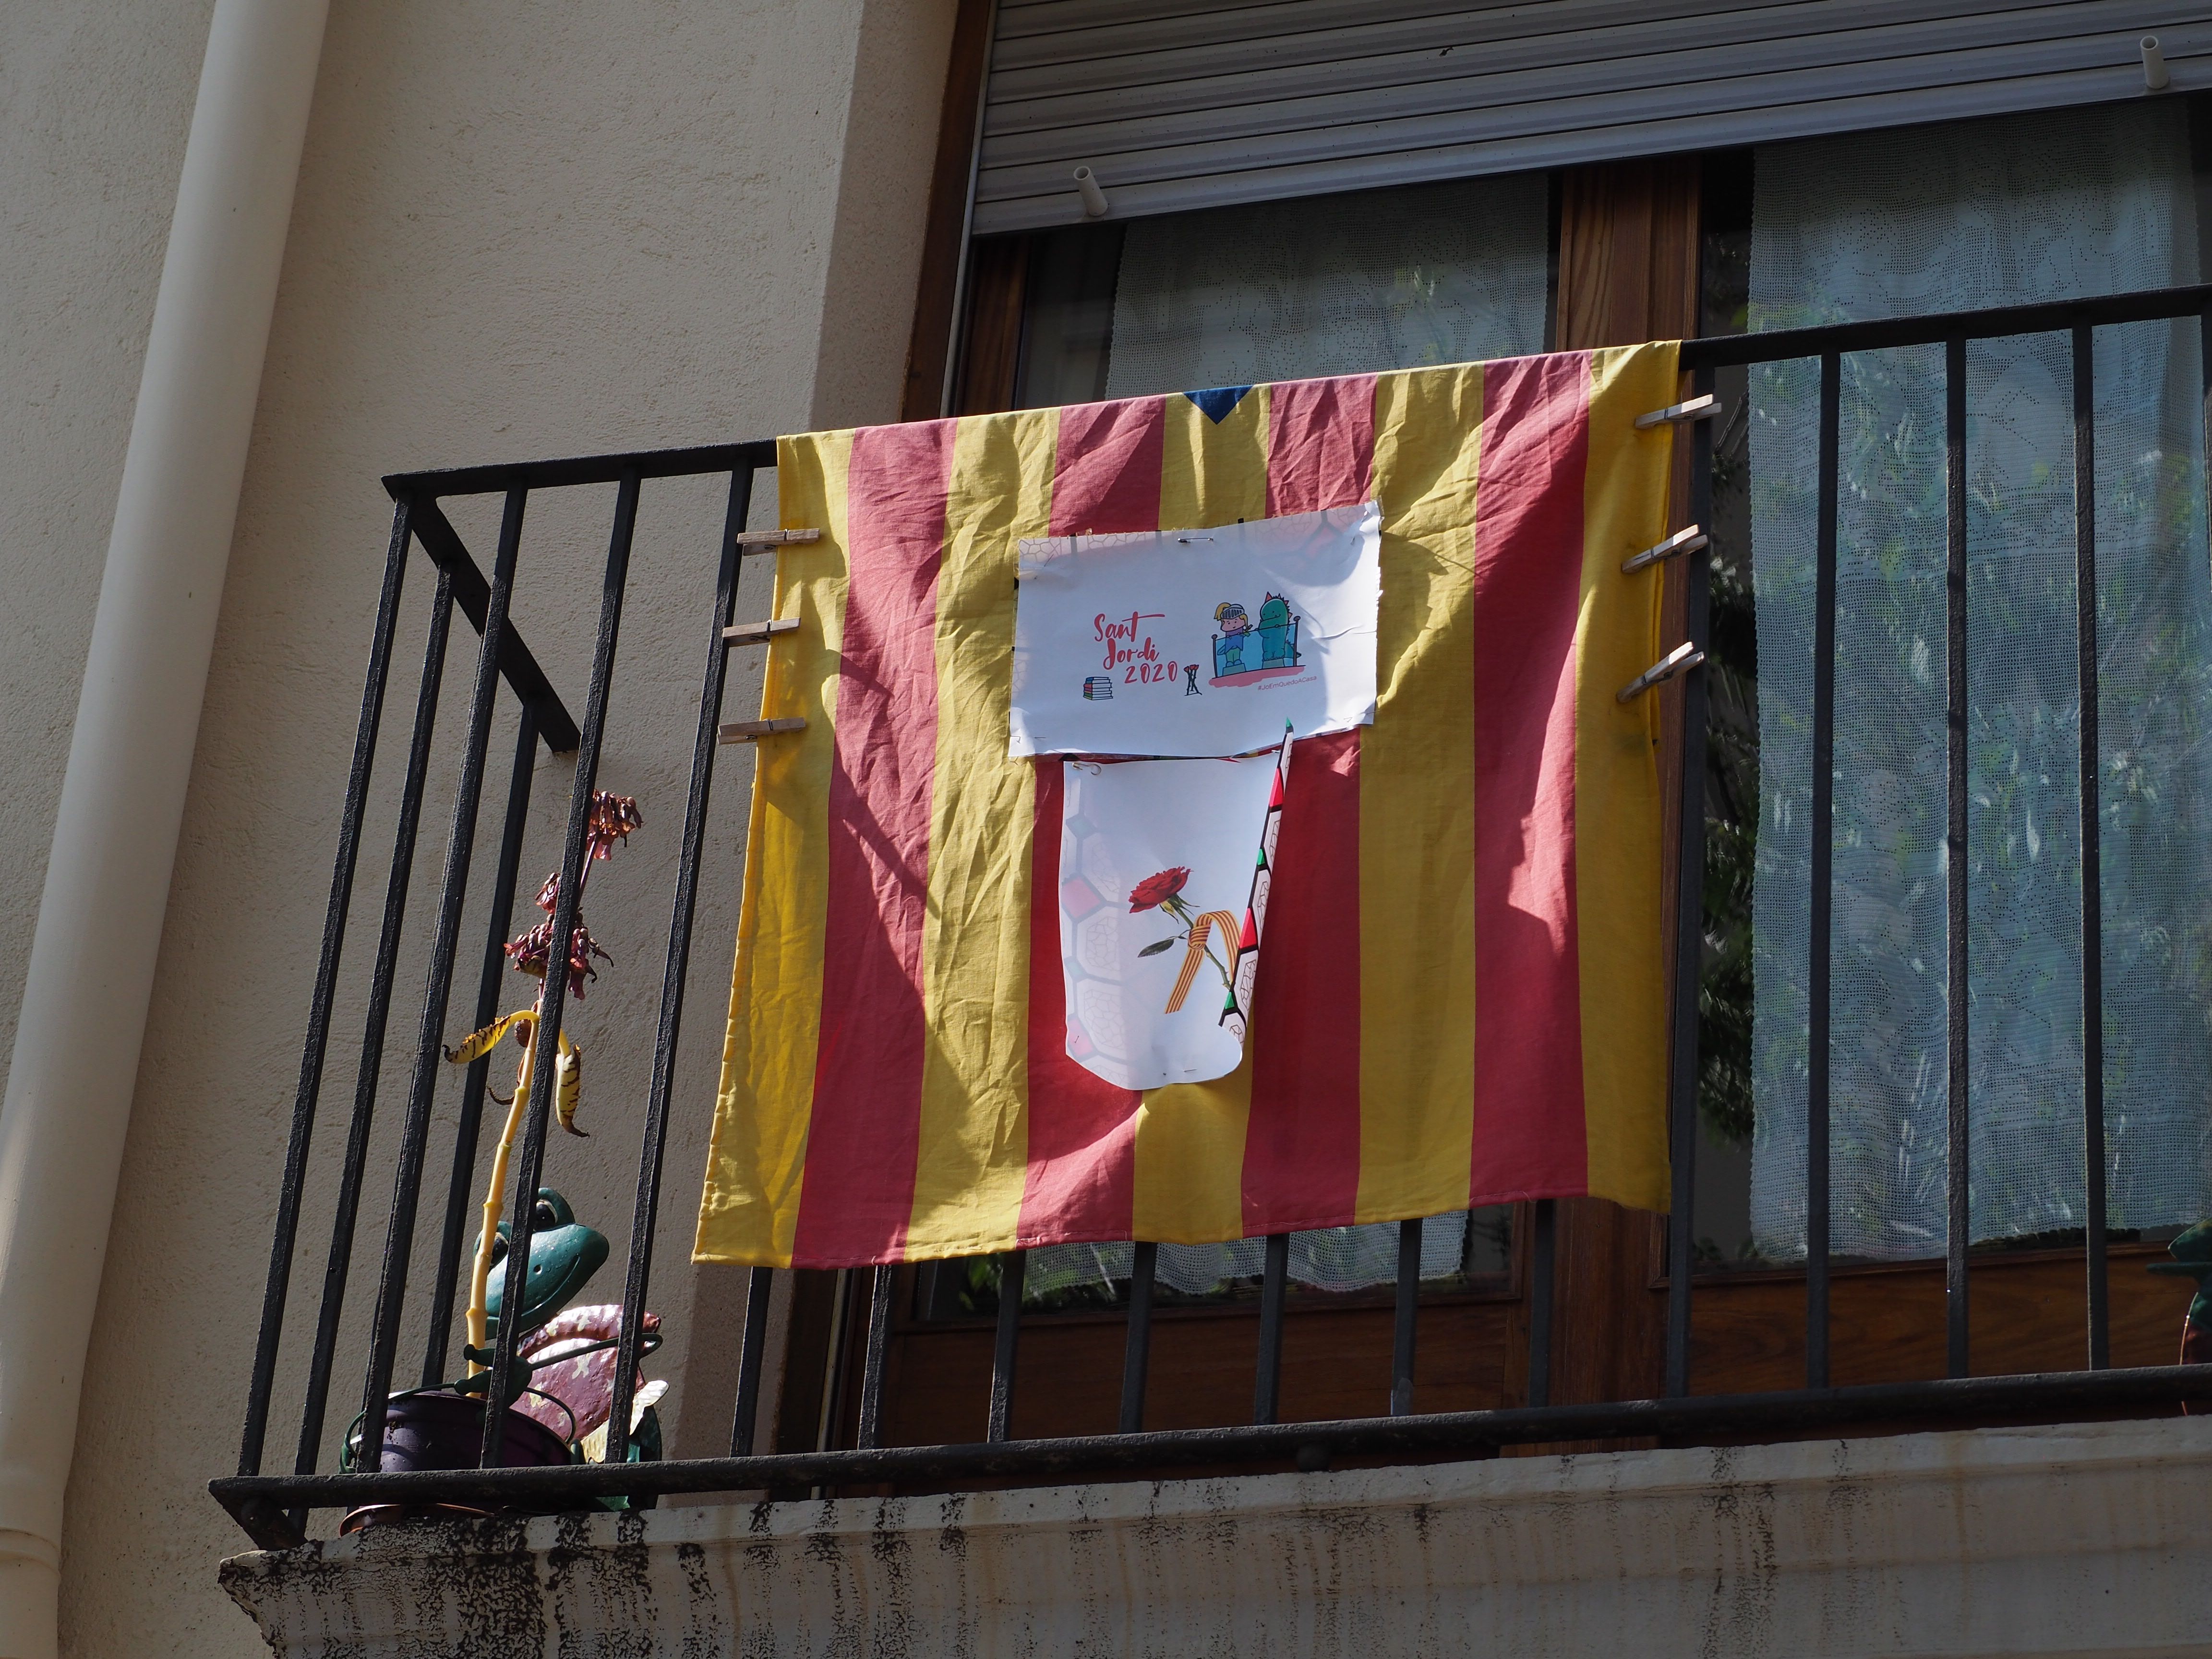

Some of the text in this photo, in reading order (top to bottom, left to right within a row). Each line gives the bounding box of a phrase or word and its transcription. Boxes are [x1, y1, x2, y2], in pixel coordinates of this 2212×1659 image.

[1094, 611, 1165, 642] Sant
[1103, 637, 1160, 670] Jordi
[1124, 661, 1178, 684] 2020
[1258, 676, 1317, 690] #JoEmQuedoACasa
